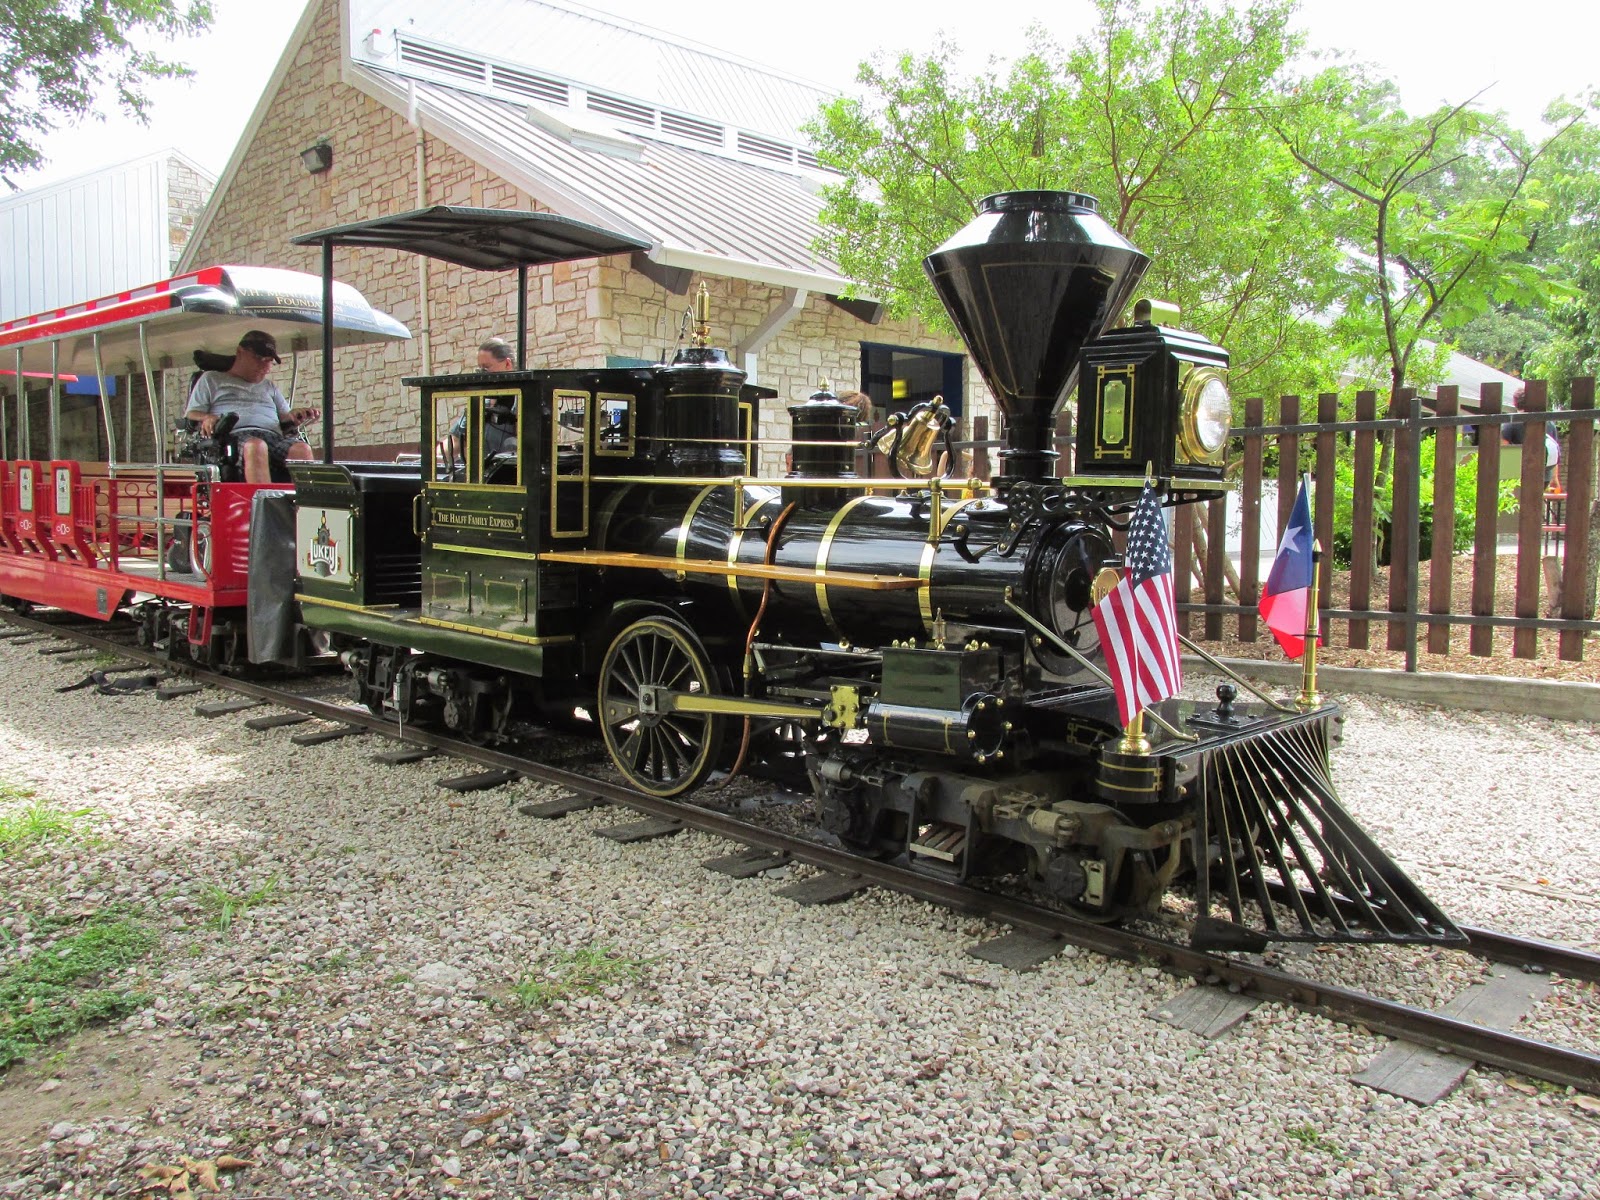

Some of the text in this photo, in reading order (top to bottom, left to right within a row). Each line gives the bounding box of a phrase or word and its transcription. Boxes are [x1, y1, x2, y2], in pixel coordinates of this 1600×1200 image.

[276, 296, 344, 314] FOUNDAON
[438, 512, 515, 528] THE HALFF FAMILY EXPRESS
[310, 538, 339, 575] LUKEY
